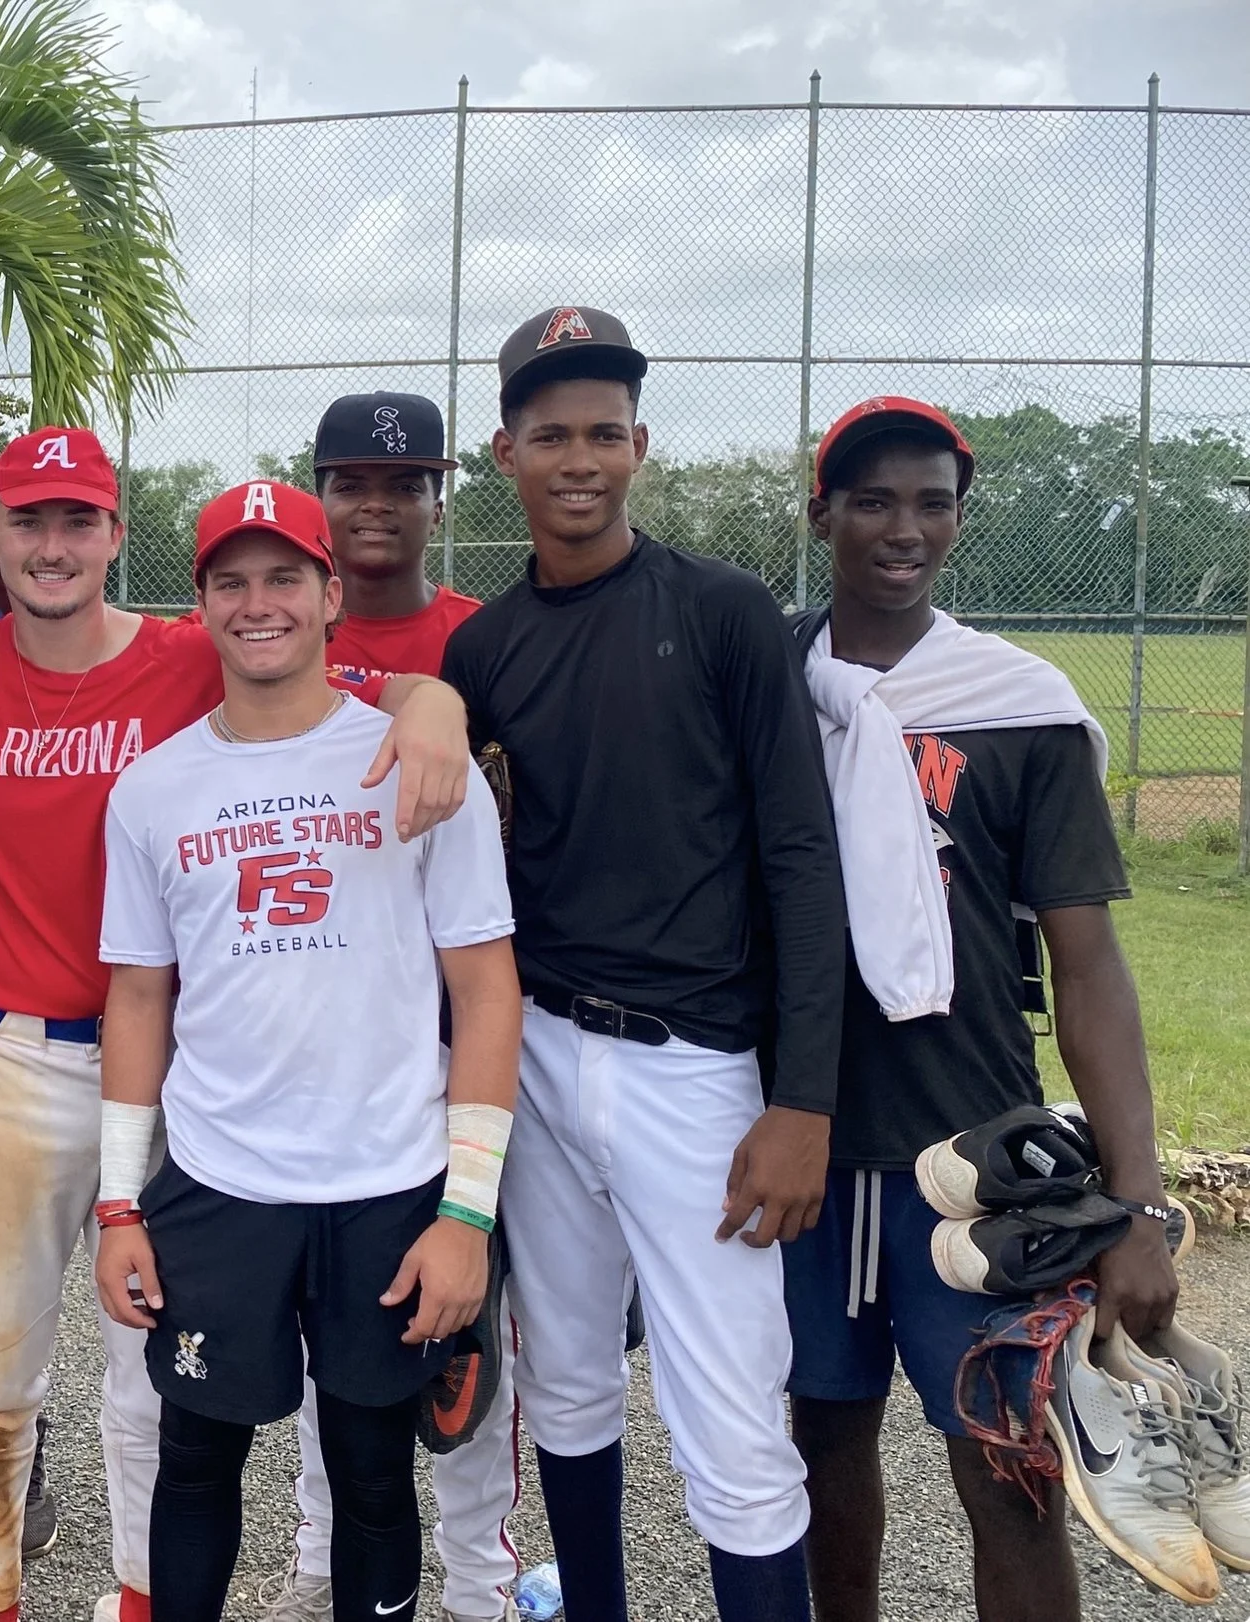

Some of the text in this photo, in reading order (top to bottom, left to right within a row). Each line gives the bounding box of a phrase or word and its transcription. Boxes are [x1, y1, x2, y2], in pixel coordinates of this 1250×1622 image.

[32, 434, 78, 470] A
[240, 483, 279, 523] A
[216, 793, 336, 822] ARIZONA
[177, 810, 382, 873] FUTURE STARS
[237, 851, 334, 926] FS
[232, 934, 348, 956] BASEBALL
